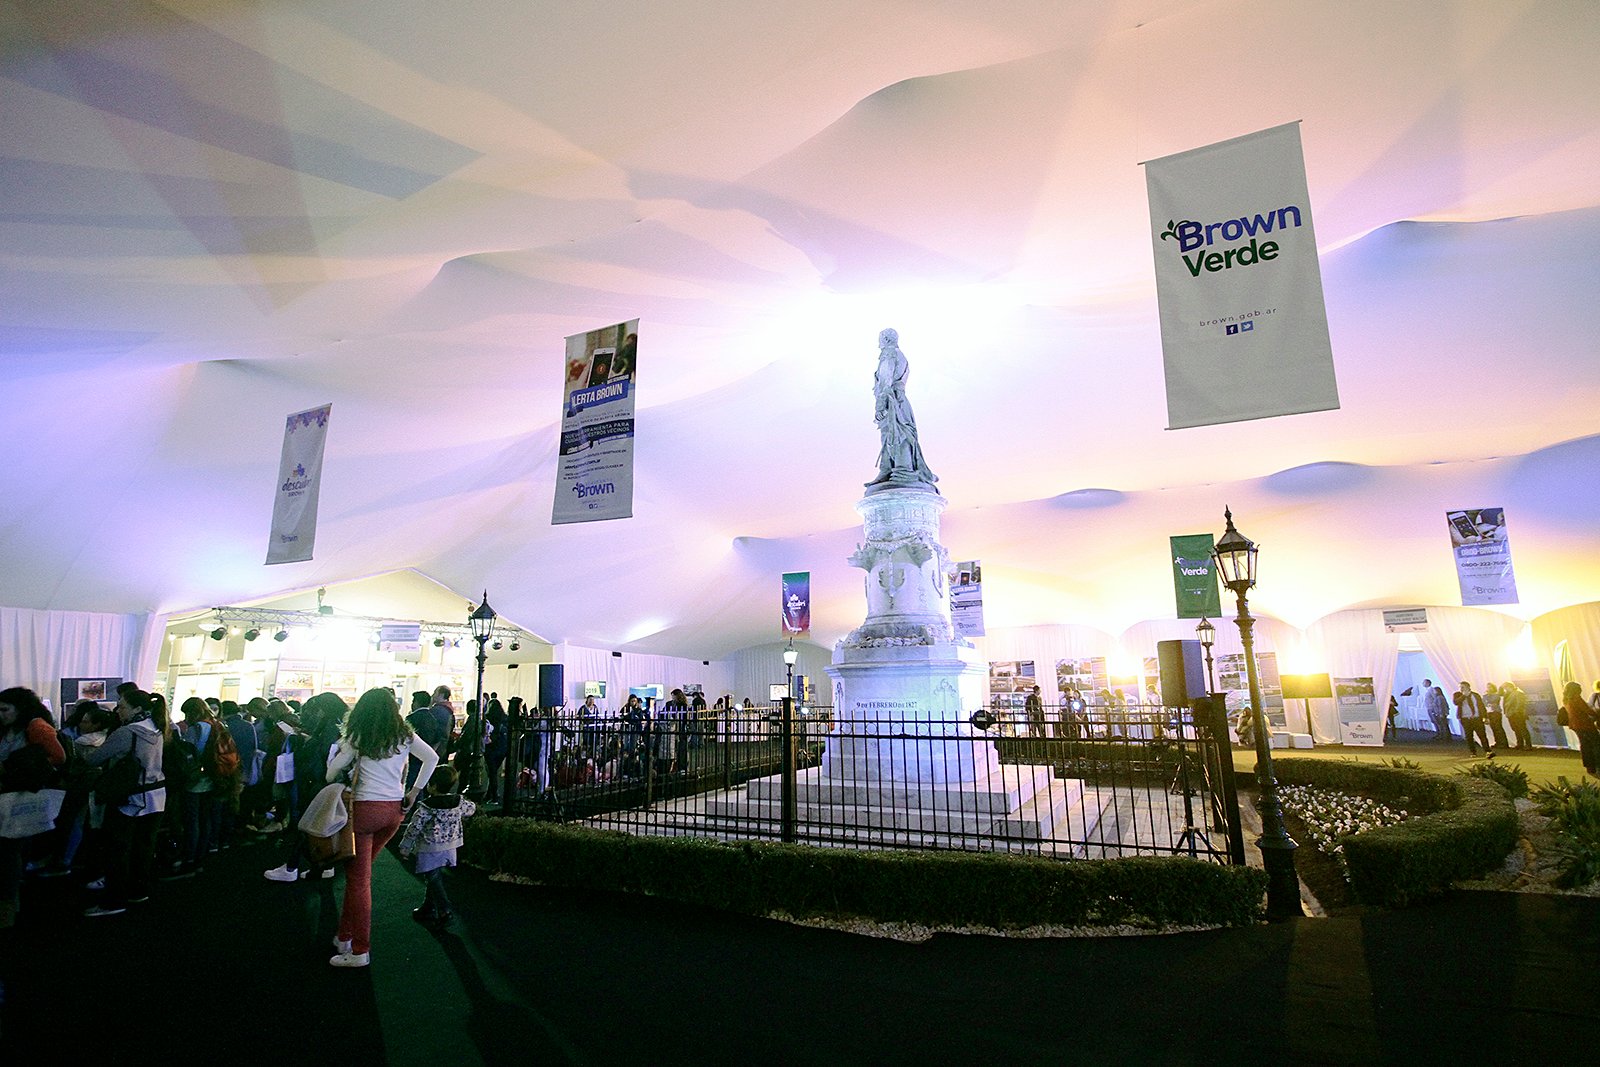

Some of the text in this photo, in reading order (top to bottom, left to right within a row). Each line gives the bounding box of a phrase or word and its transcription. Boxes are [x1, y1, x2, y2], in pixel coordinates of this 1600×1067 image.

[1178, 205, 1302, 253] Brown
[1182, 238, 1280, 278] Verde
[1200, 307, 1277, 327] brown.gob.ar
[596, 383, 623, 401] BROWN
[577, 482, 614, 499] Brown
[1181, 566, 1208, 576] Verde
[1476, 586, 1507, 594] Brown
